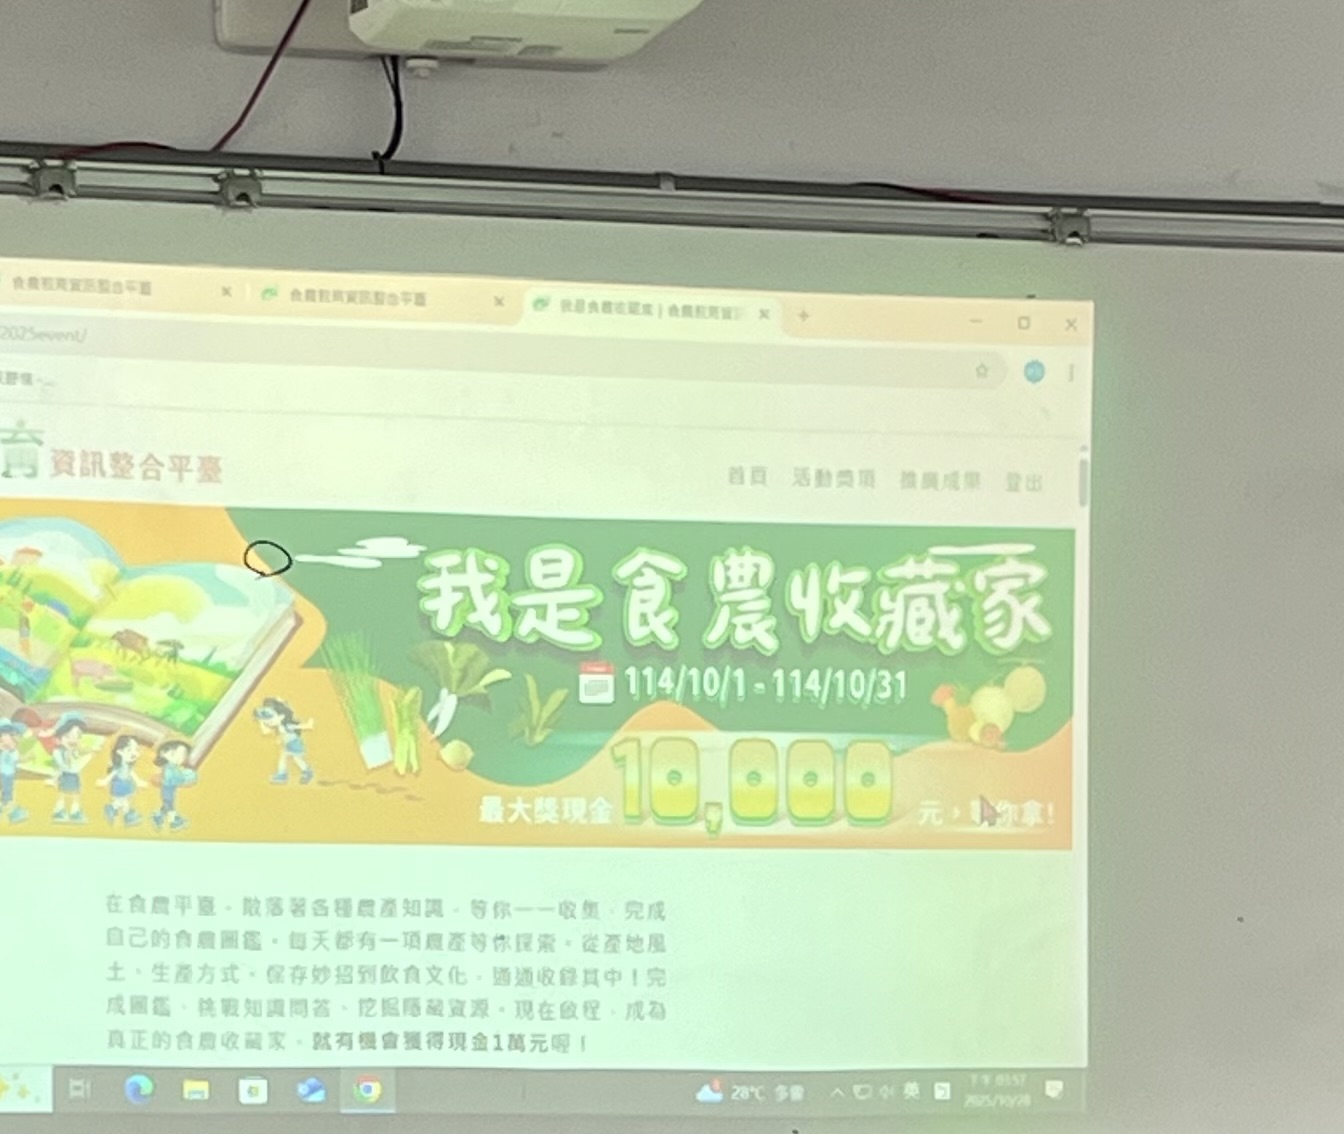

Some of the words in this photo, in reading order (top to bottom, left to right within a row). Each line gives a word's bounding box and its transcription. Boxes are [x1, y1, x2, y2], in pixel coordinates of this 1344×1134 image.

[50, 449, 223, 484] 資訊整合平臺
[418, 544, 1053, 655] 我是食農收藏家
[624, 665, 746, 706] 114/10/1
[772, 667, 908, 708] 114/10/31
[479, 796, 614, 824] 最大獎現金
[610, 736, 894, 837] 10,000
